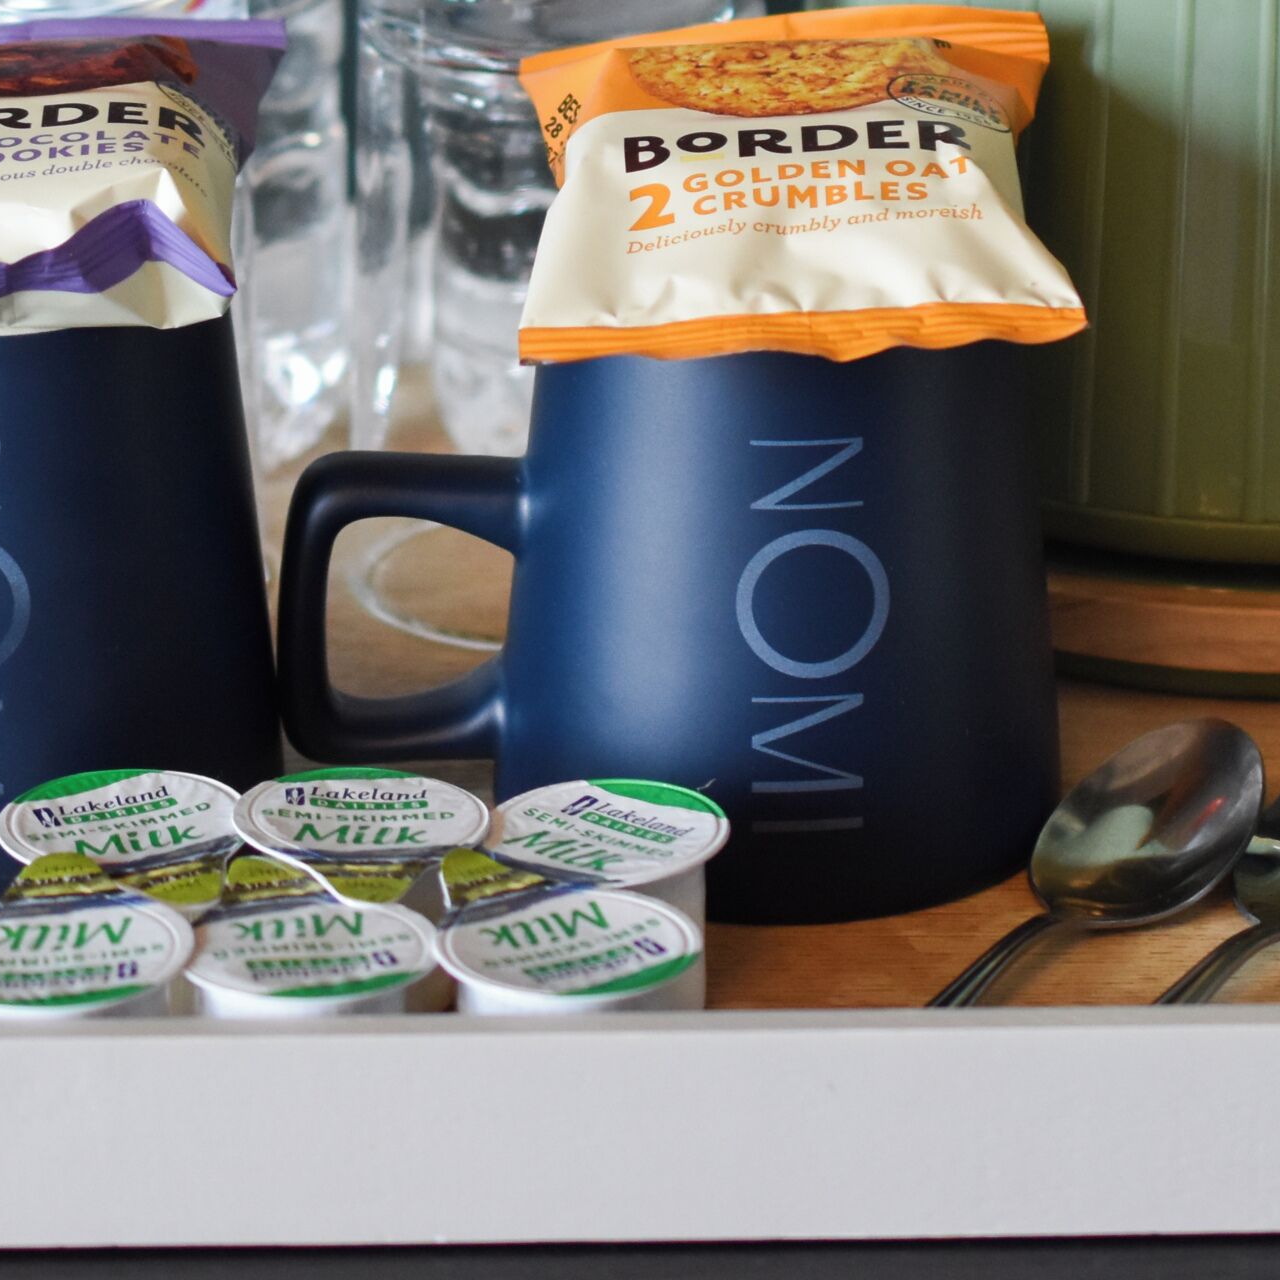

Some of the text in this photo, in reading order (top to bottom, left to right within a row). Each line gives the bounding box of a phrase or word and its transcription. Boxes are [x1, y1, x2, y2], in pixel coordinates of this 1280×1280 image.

[545, 116, 564, 138] 28
[623, 119, 972, 173] BORDER
[42, 158, 112, 179] double
[682, 155, 970, 194] GOLDEN OAT
[628, 182, 676, 232] 2
[692, 181, 929, 217] CRUMBLES
[626, 202, 984, 255] Deliciously crumbly and moreish
[735, 436, 891, 833] NOMI
[58, 785, 171, 816] Lakeland
[310, 786, 427, 801] Lakeland
[317, 799, 421, 810] DAIRIES
[26, 801, 212, 842] SEMI-SKIMMED
[69, 798, 172, 824] DAIRIES
[261, 807, 456, 822] SEMI-SKIMMED
[594, 802, 696, 838] Lakeland
[74, 824, 206, 857] Milk
[293, 823, 428, 845] Milk
[523, 807, 674, 857] SEMI-SKIMMED
[586, 813, 671, 844] DAIRIES
[502, 830, 624, 872] Milk
[231, 911, 364, 942] Milk
[478, 900, 609, 949] Milk
